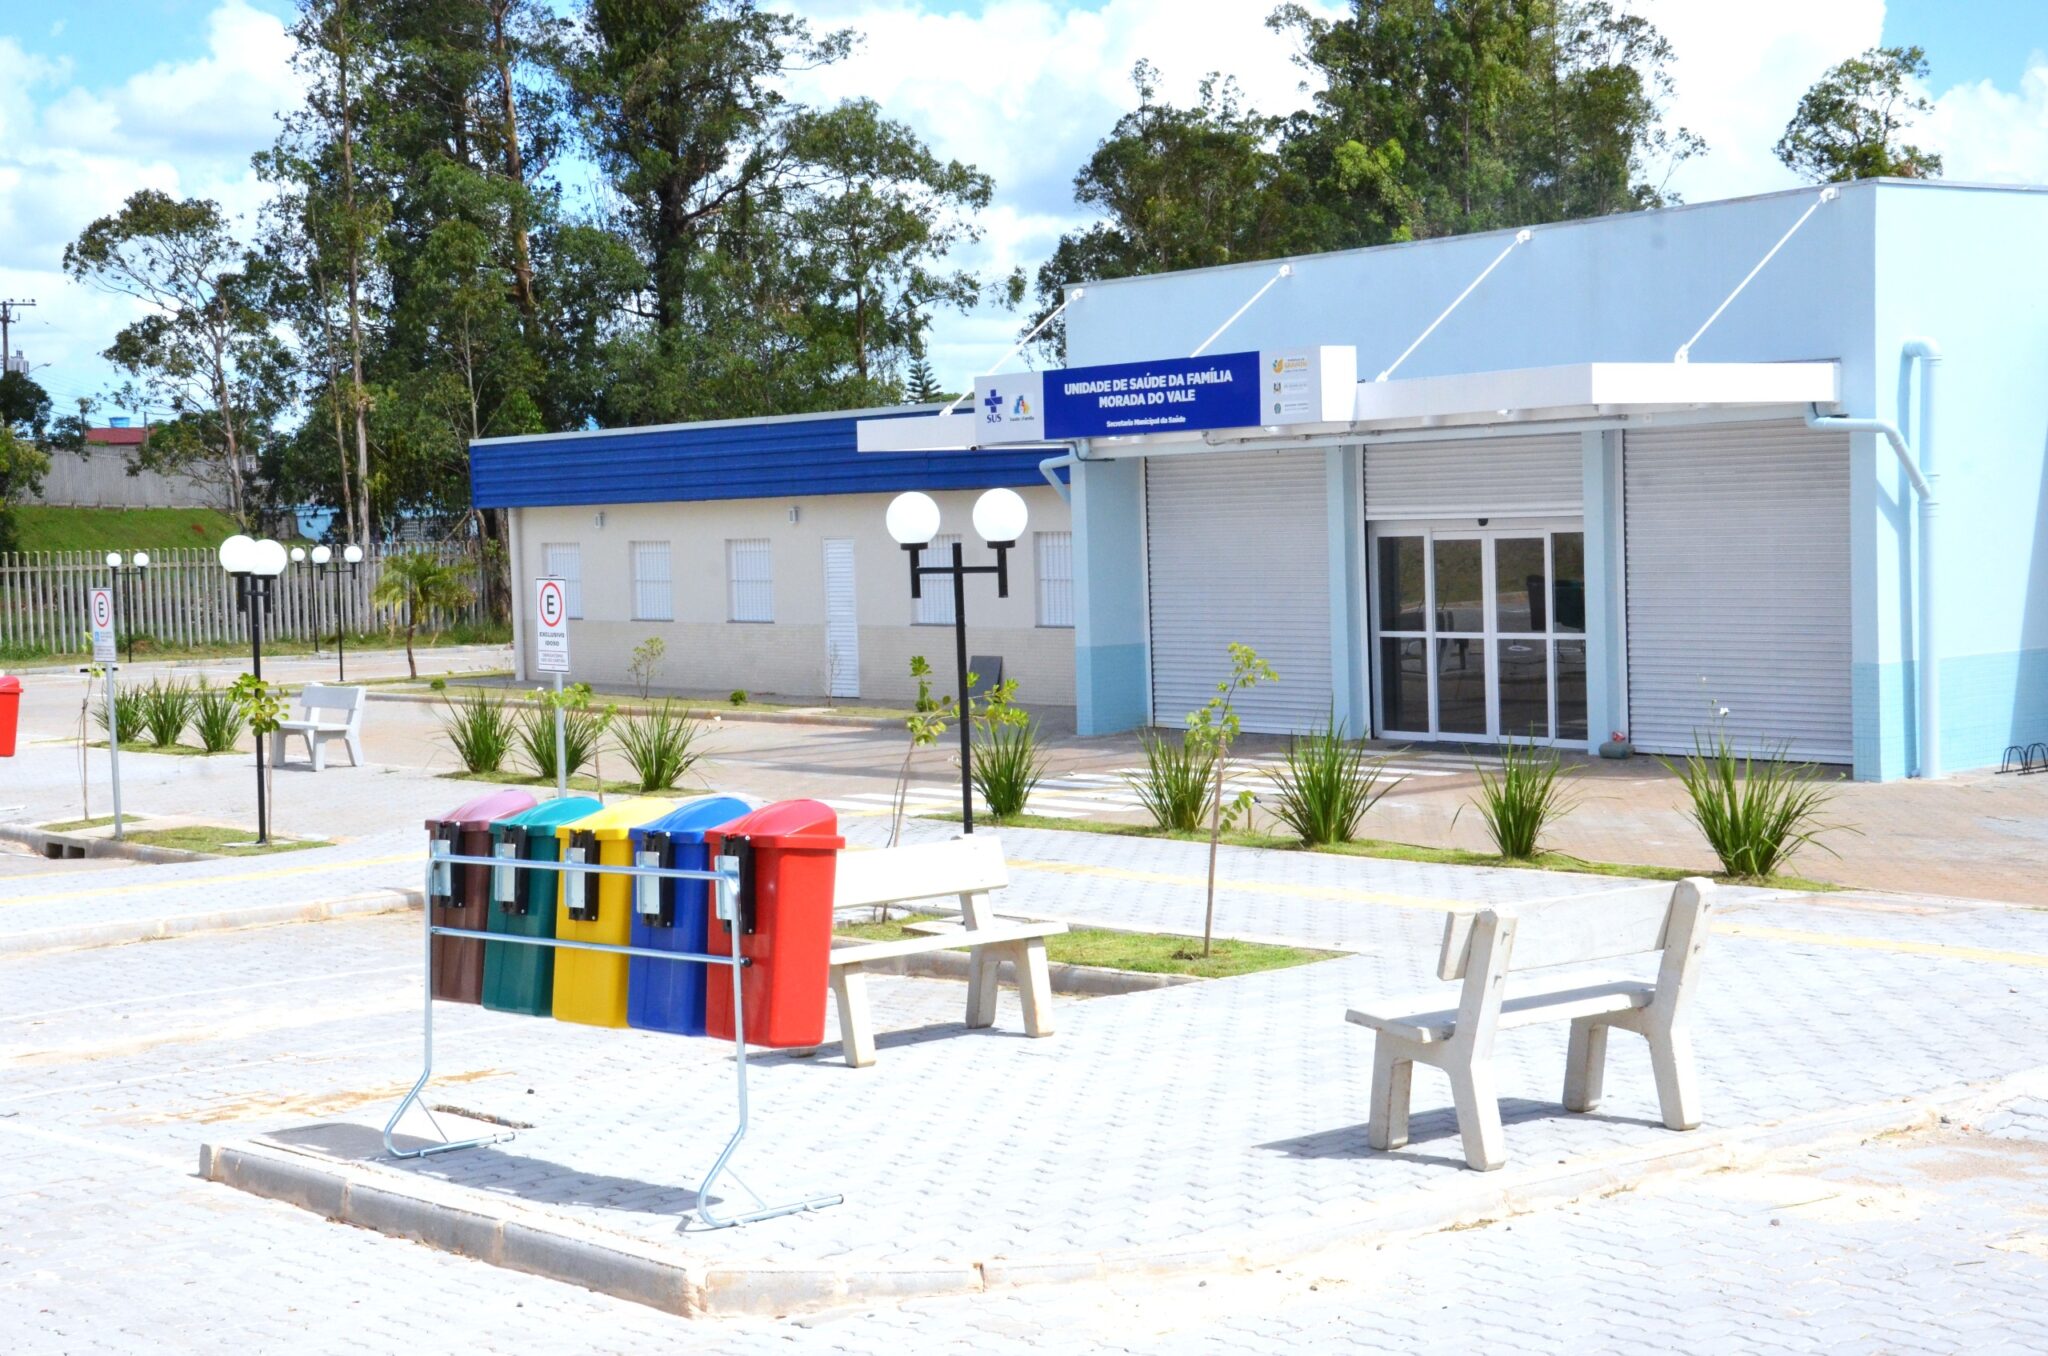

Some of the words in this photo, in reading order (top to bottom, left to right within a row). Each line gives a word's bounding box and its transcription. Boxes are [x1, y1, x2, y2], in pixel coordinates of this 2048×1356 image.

[1064, 380, 1111, 396] UNIDADE
[1113, 378, 1128, 391] DE
[1129, 372, 1166, 389] SAÚDE
[1168, 373, 1185, 387] DA
[1187, 367, 1233, 385] FAMÍLIA
[1099, 393, 1146, 408] MORADA
[1148, 391, 1165, 405] DO
[1167, 389, 1196, 403] VALE
[986, 414, 1002, 423] SUS
[1134, 417, 1160, 426] Municipal
[1160, 416, 1168, 424] da
[1168, 414, 1186, 423] Saúde
[98, 601, 105, 618] E
[546, 594, 555, 615] E
